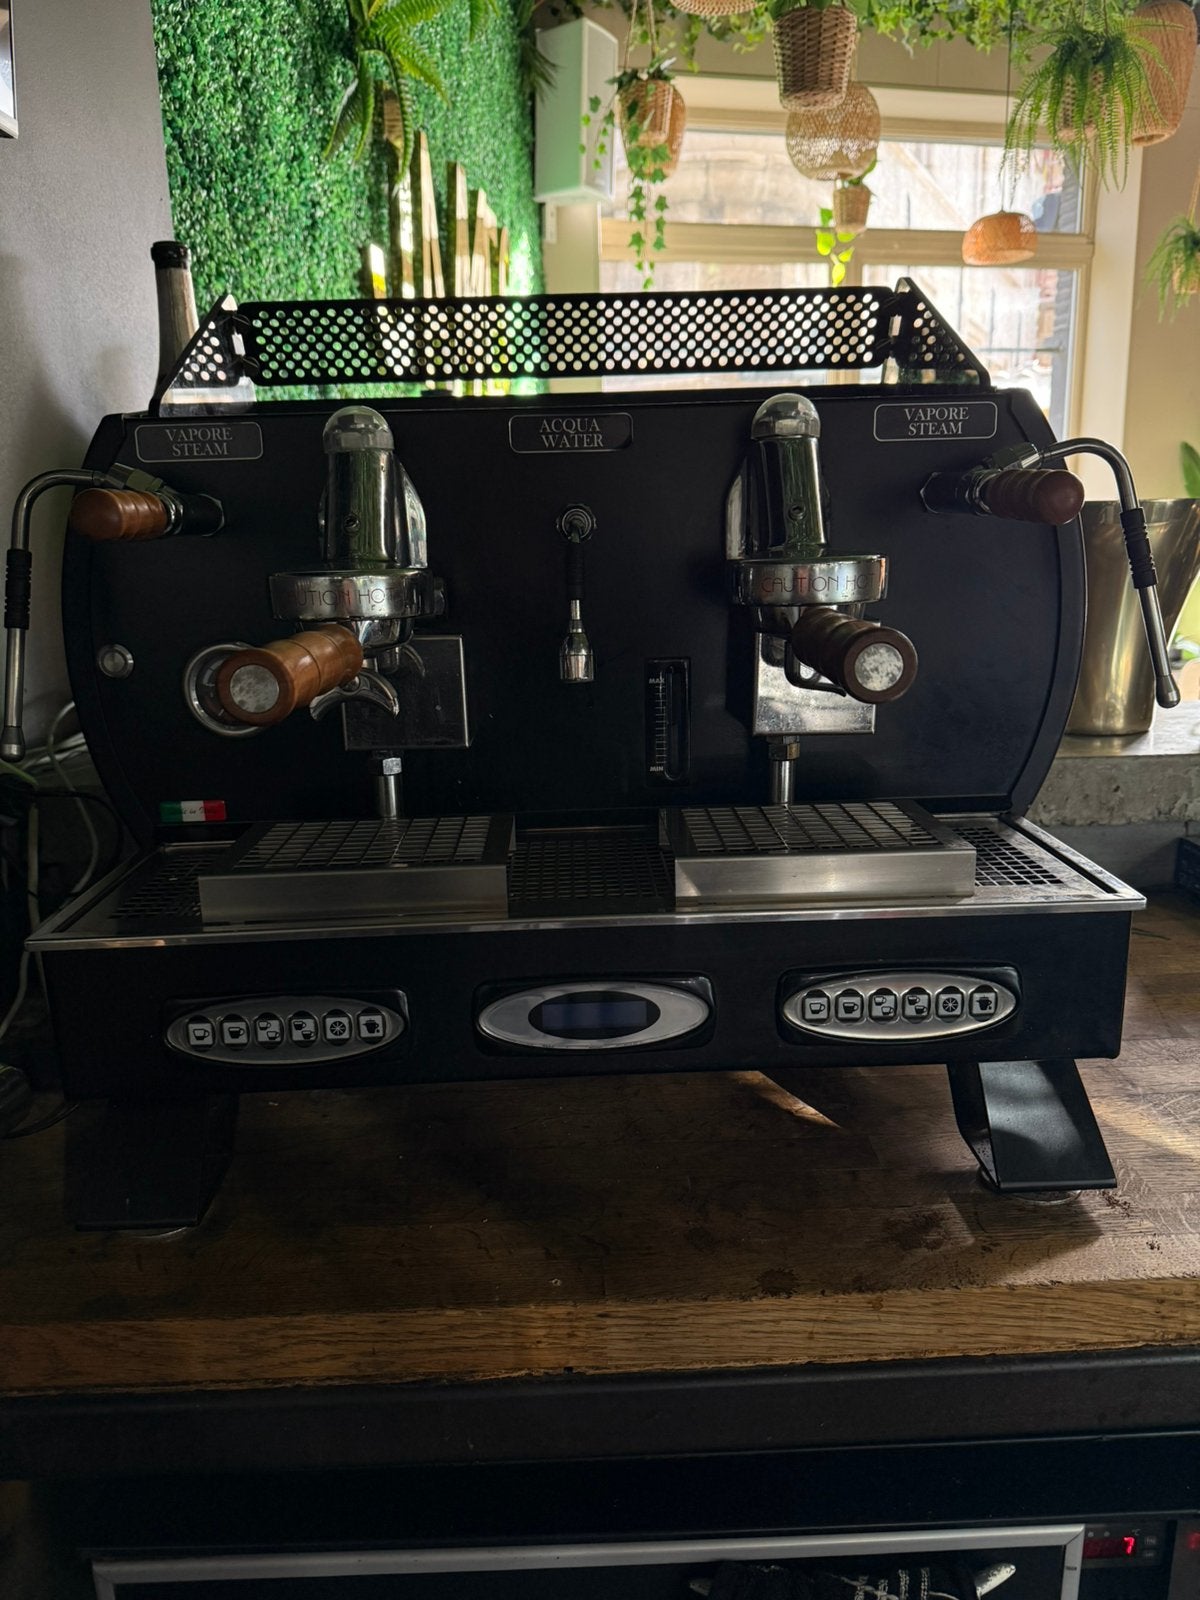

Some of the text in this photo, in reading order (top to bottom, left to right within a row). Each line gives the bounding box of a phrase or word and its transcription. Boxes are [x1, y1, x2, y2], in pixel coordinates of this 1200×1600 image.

[904, 406, 970, 421] VAPORE
[539, 417, 601, 434] ACQUA
[908, 421, 964, 437] STEAM
[165, 427, 233, 442] VAPORE
[541, 433, 604, 448] WATER
[172, 442, 229, 457] STEAM
[760, 572, 876, 593] CAUTION HOT
[1122, 1536, 1136, 1555] 7
